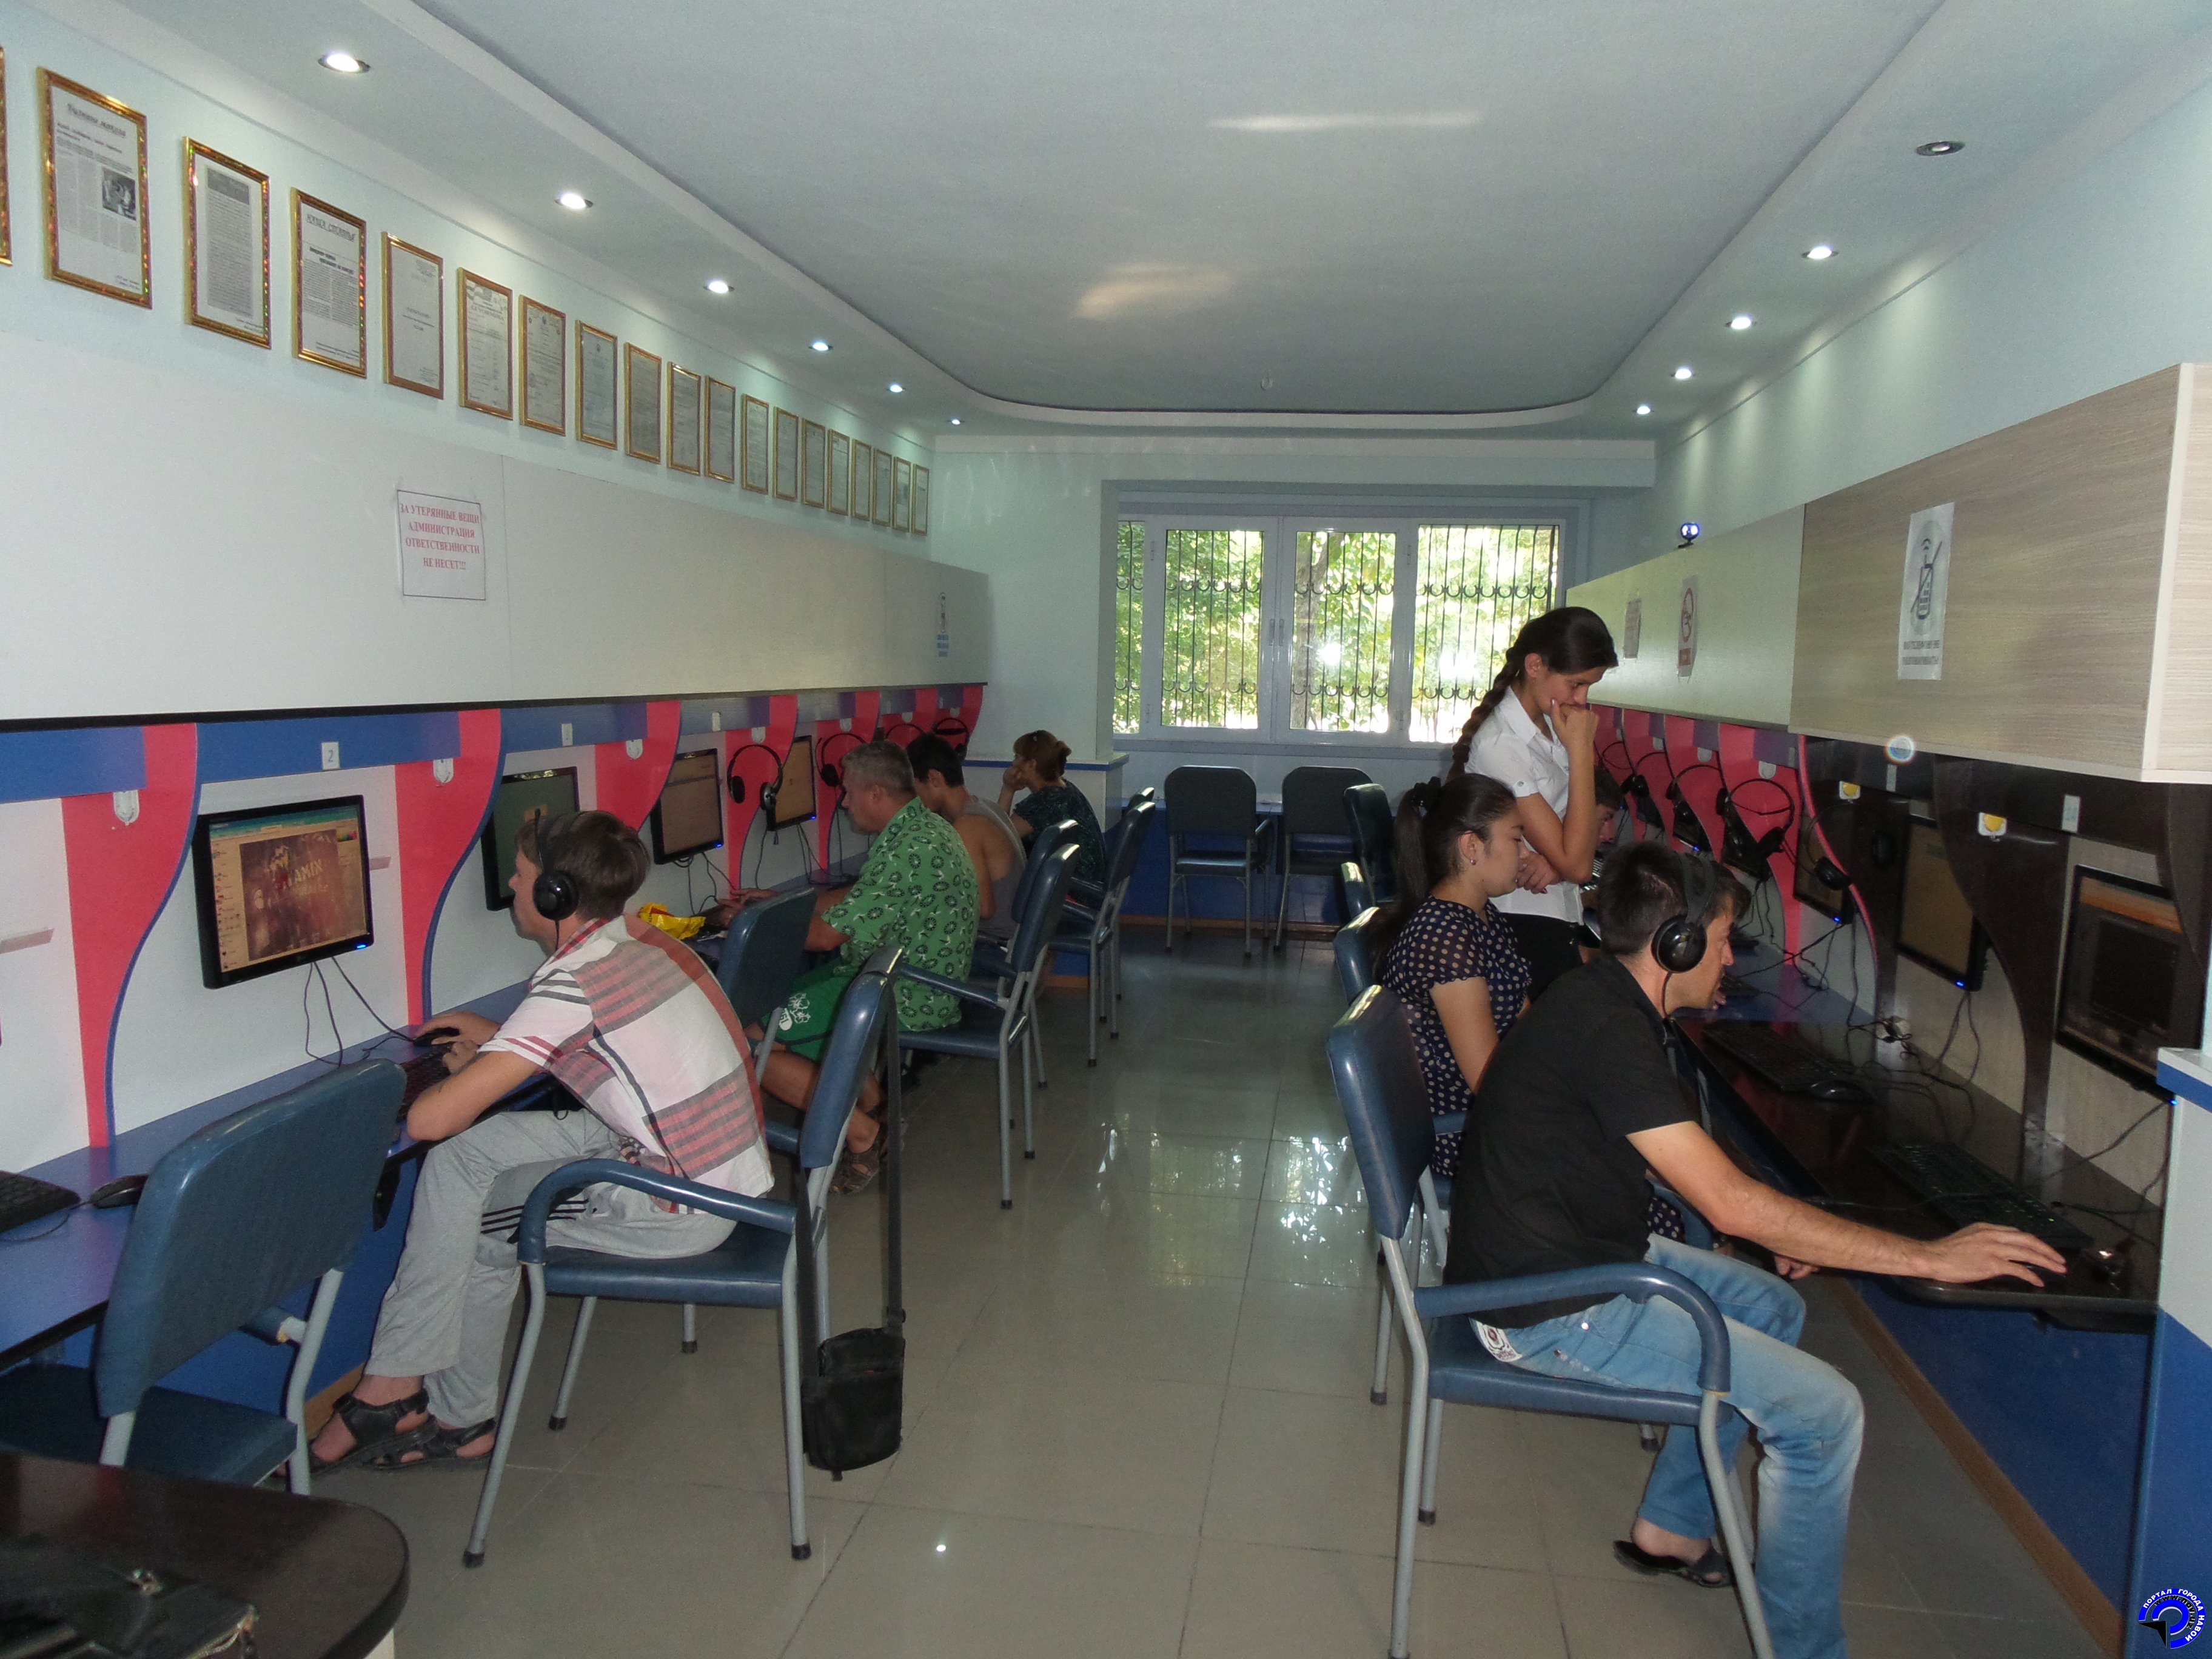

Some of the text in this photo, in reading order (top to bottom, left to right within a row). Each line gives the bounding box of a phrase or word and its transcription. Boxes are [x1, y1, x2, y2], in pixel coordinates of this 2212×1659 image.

[400, 503, 479, 523] ЗА УТЕРЯННЫЕ ВЕЩИ
[408, 521, 475, 538] АДМИНИСТРАЦИЯ
[406, 537, 480, 554] ОТВЕТСТВЕННОСТИ
[423, 557, 466, 570] НЕ НЕСЕТ!!!
[328, 749, 333, 762] 2
